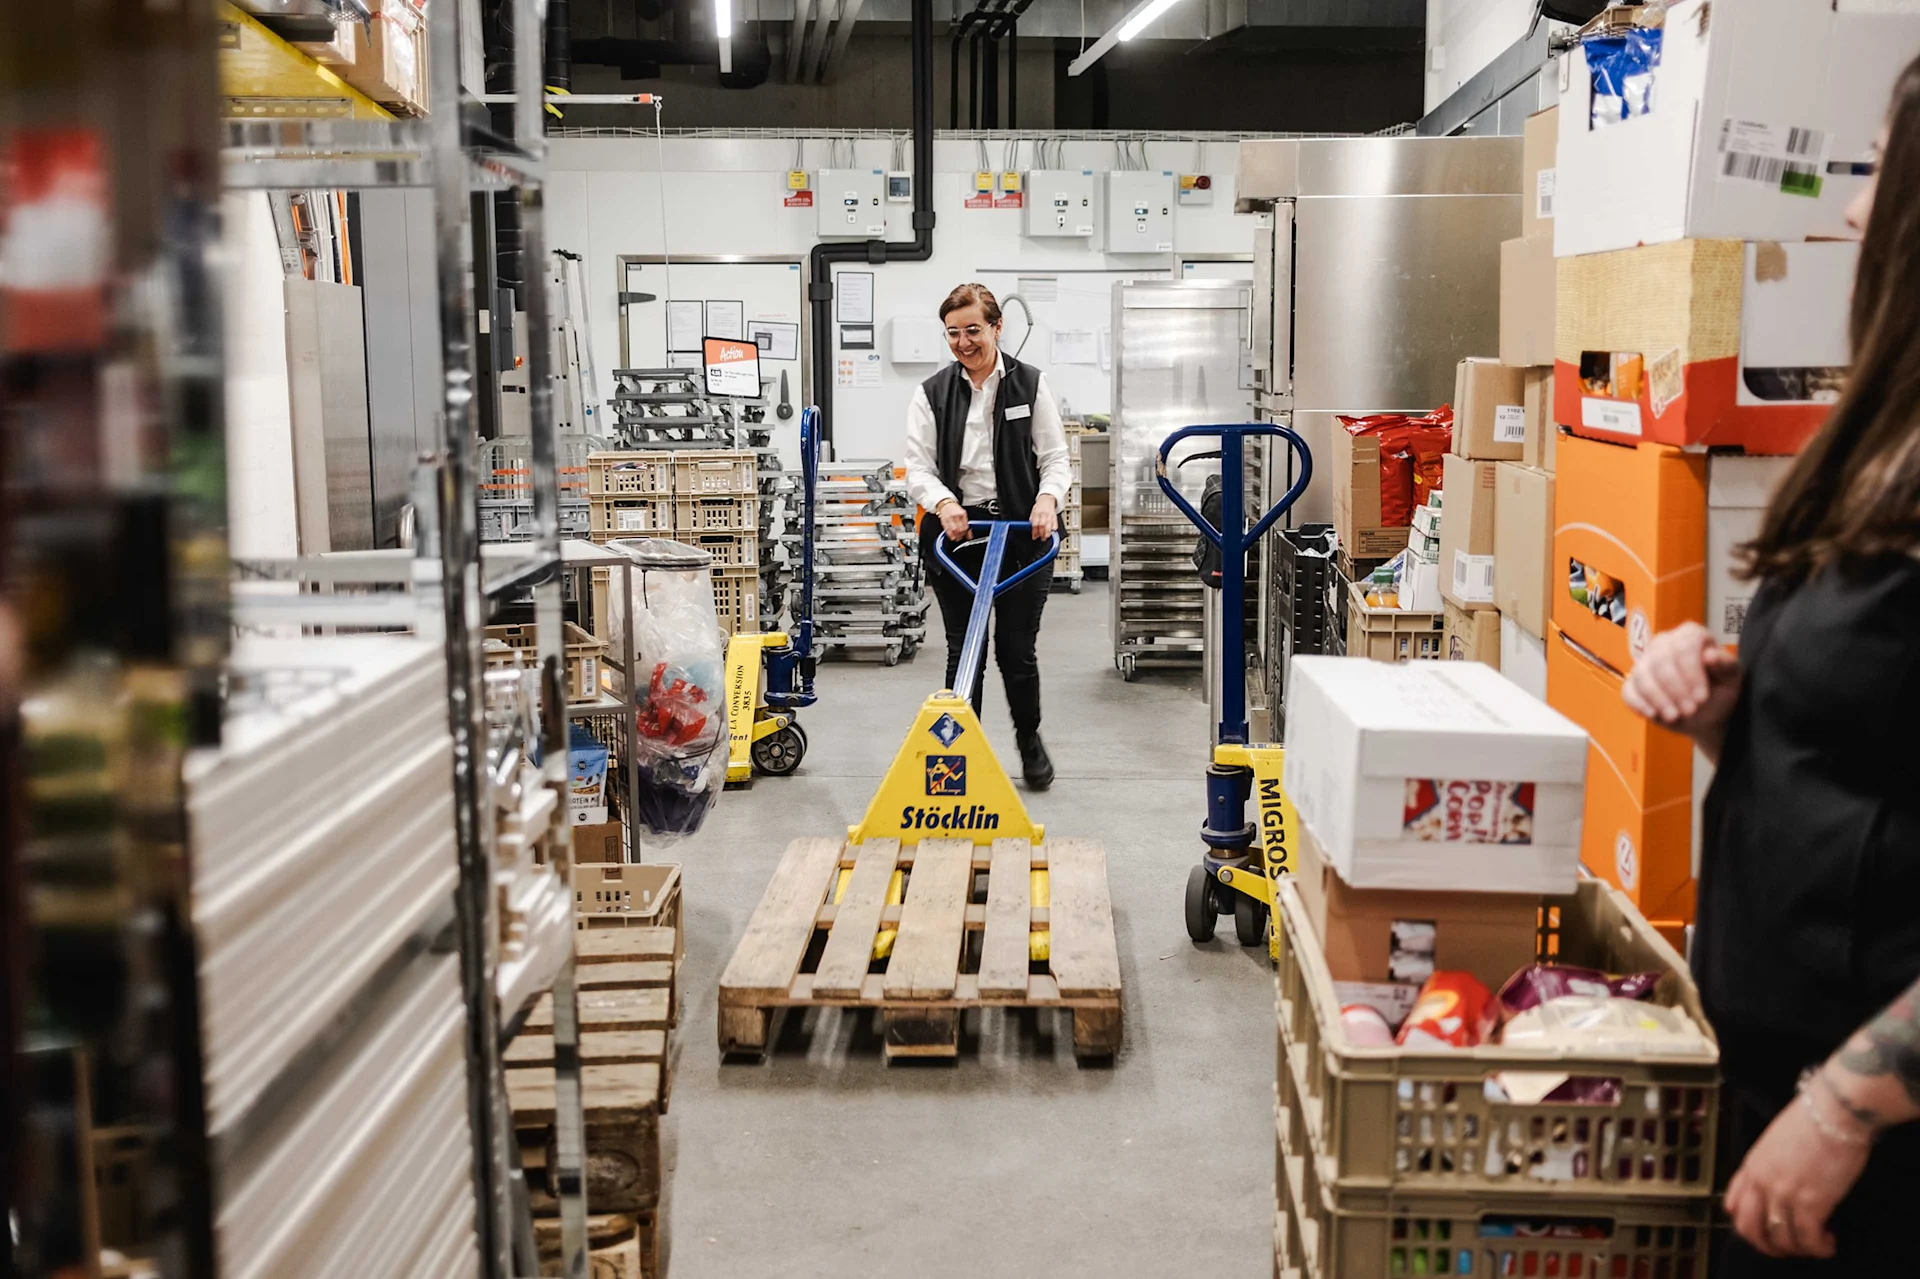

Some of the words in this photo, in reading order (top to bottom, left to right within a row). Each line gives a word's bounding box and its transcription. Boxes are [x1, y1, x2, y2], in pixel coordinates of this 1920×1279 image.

[720, 345, 744, 361] Action
[731, 665, 744, 717] CONVERSION
[743, 690, 752, 711] 3835
[729, 719, 737, 730] LA
[900, 805, 999, 829] Stöcklin
[1260, 778, 1289, 882] MIGROS
